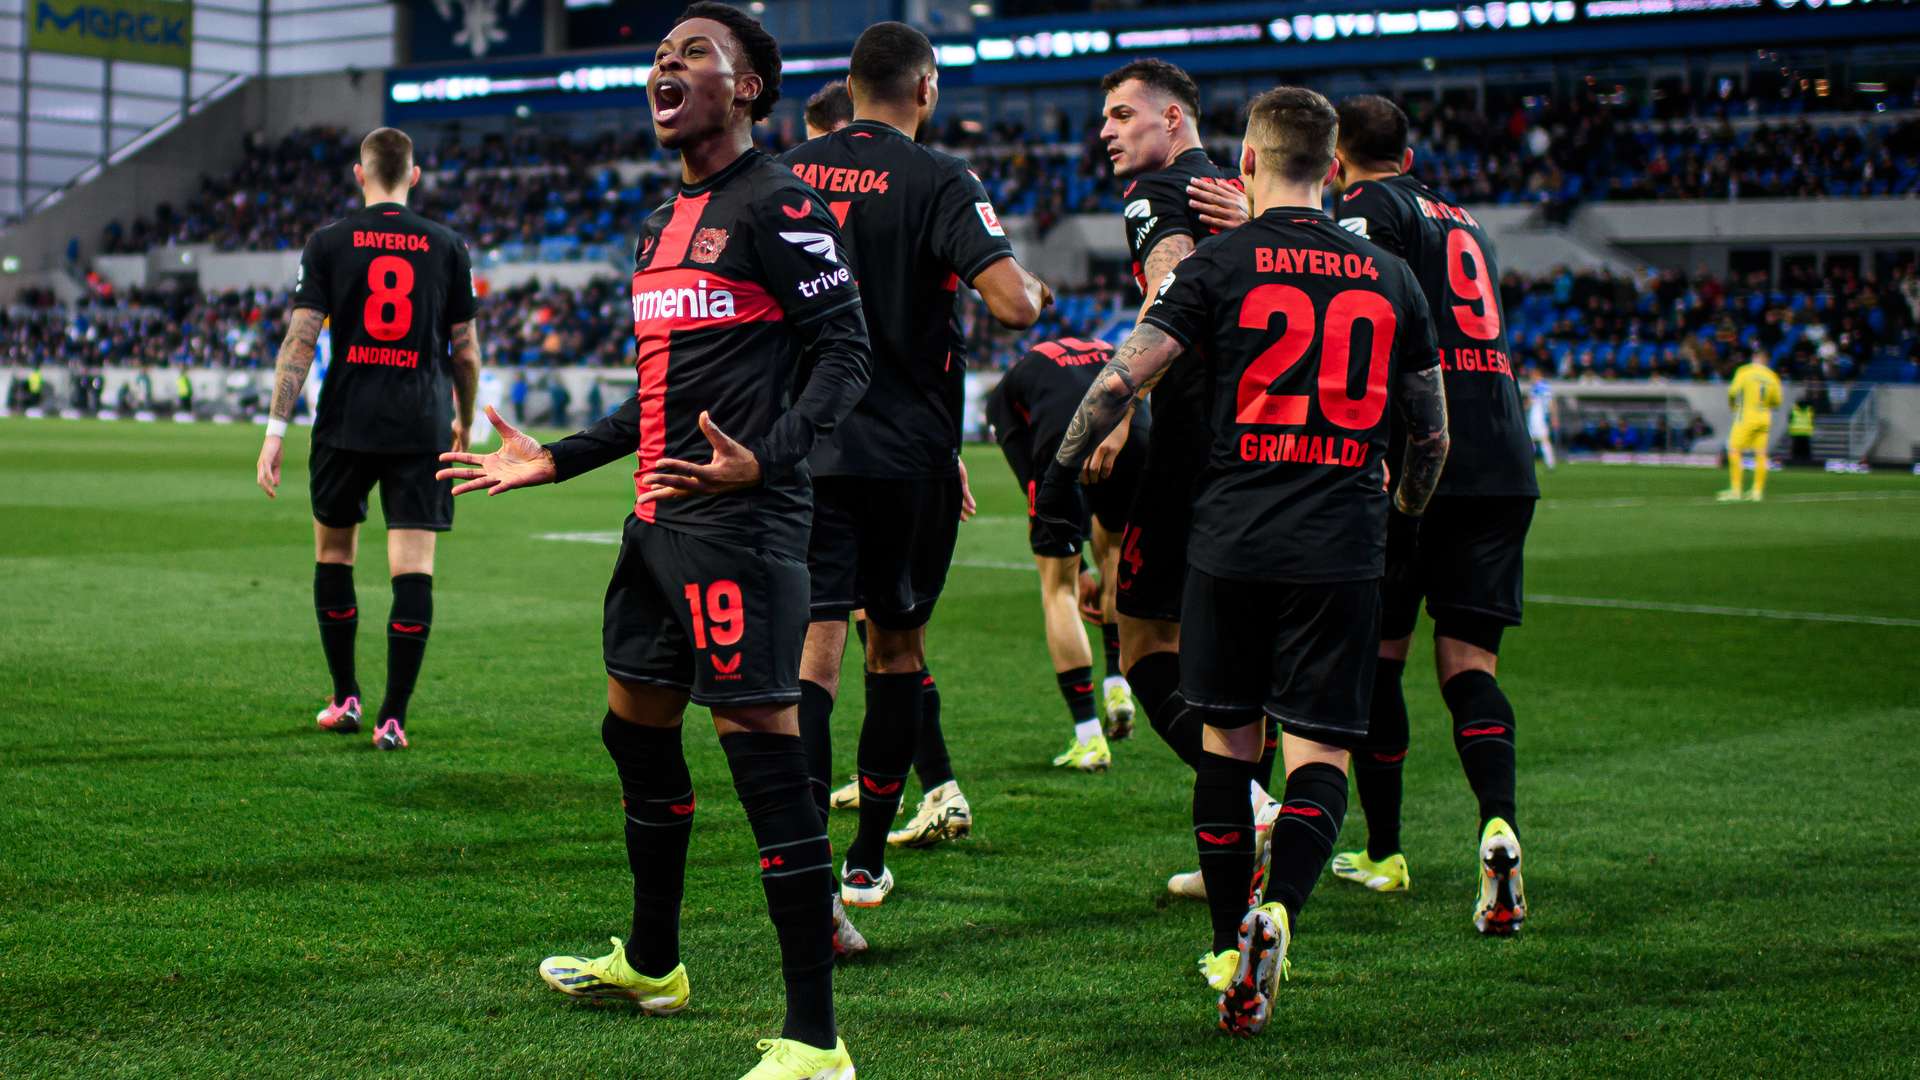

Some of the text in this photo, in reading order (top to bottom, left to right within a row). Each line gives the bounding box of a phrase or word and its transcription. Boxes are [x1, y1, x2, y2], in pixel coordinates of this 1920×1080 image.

[364, 255, 415, 342] 8
[798, 267, 850, 298] trive
[1447, 228, 1500, 340] 9
[346, 345, 419, 369] ANDRICH
[1235, 283, 1397, 430] 20
[1240, 432, 1369, 468] GRIMALDO
[684, 578, 745, 649] 19
